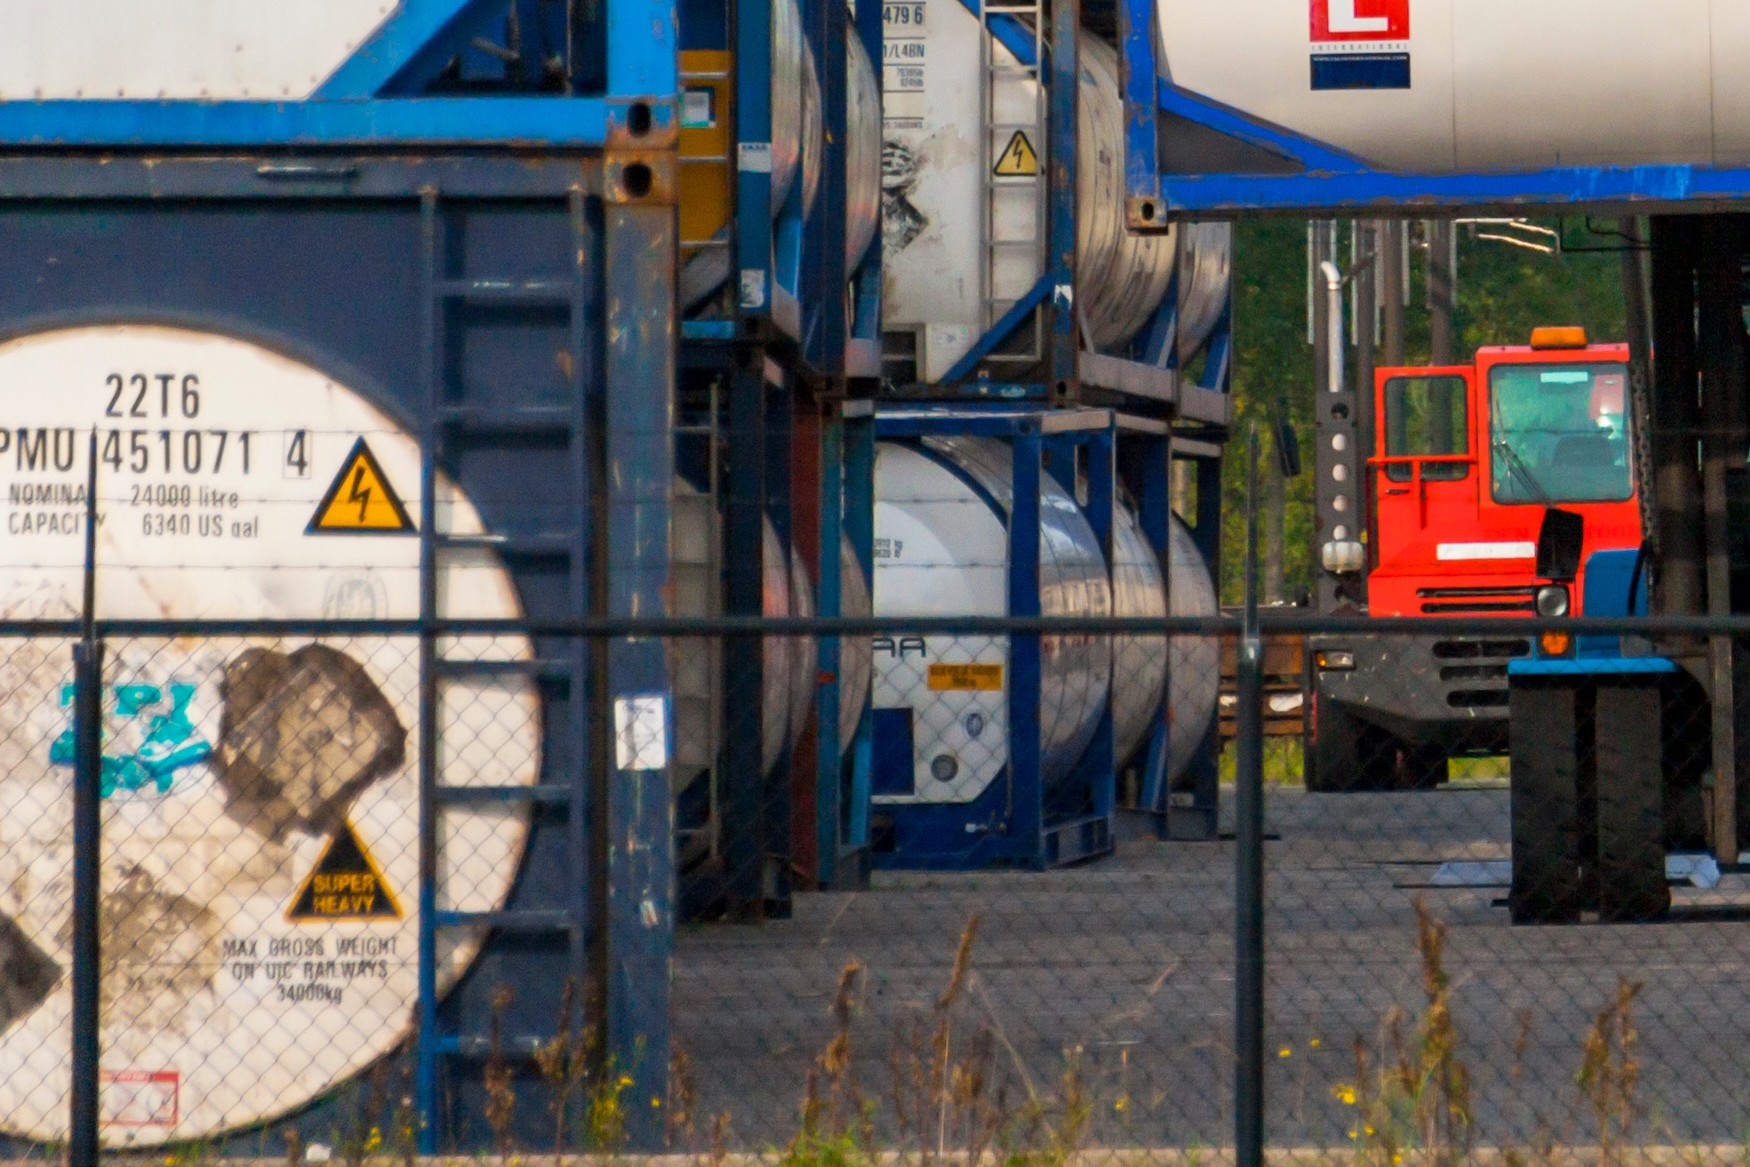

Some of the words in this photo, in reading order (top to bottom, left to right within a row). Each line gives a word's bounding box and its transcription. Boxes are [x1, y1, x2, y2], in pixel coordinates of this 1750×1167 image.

[914, 6, 923, 24] 6
[105, 373, 200, 418] 22T6
[102, 429, 251, 474] 451071
[287, 429, 308, 476] 4
[131, 484, 192, 507] 24000
[199, 485, 240, 509] litre
[142, 513, 191, 537] 6340
[199, 514, 223, 537] US
[231, 516, 259, 538] gal
[313, 873, 375, 894] SUPER
[313, 895, 375, 913] HEAVY
[223, 938, 257, 956] MAX
[269, 938, 324, 956] GROSS
[336, 936, 398, 955] WEIGHT
[232, 962, 256, 979] ON
[266, 961, 293, 979] UIC
[303, 959, 388, 979] RAILWAYS
